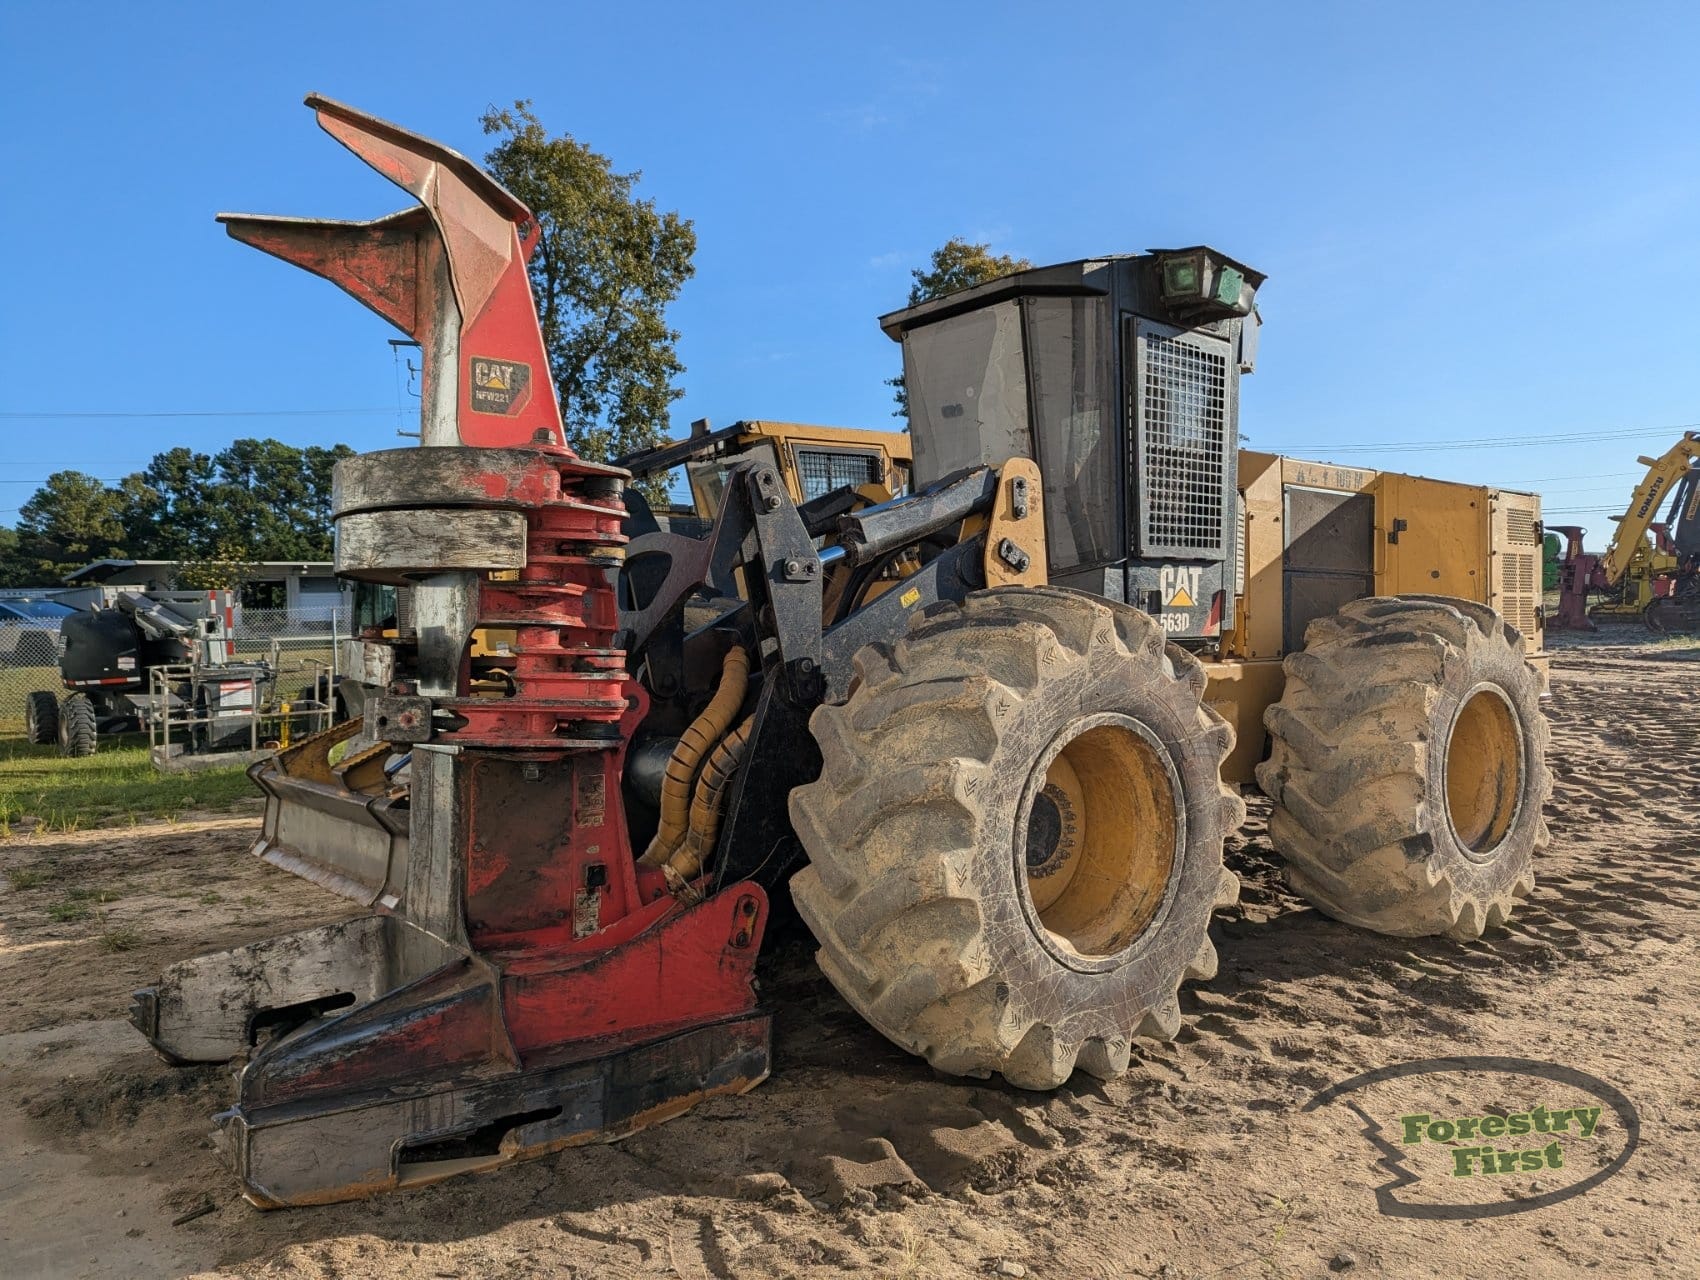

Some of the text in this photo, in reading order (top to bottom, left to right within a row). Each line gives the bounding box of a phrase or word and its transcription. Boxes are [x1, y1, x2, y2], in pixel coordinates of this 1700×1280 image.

[475, 362, 513, 389] CAT
[1637, 476, 1664, 519] KOMATSU
[1160, 564, 1203, 607] CAT
[1159, 613, 1190, 632] 563D
